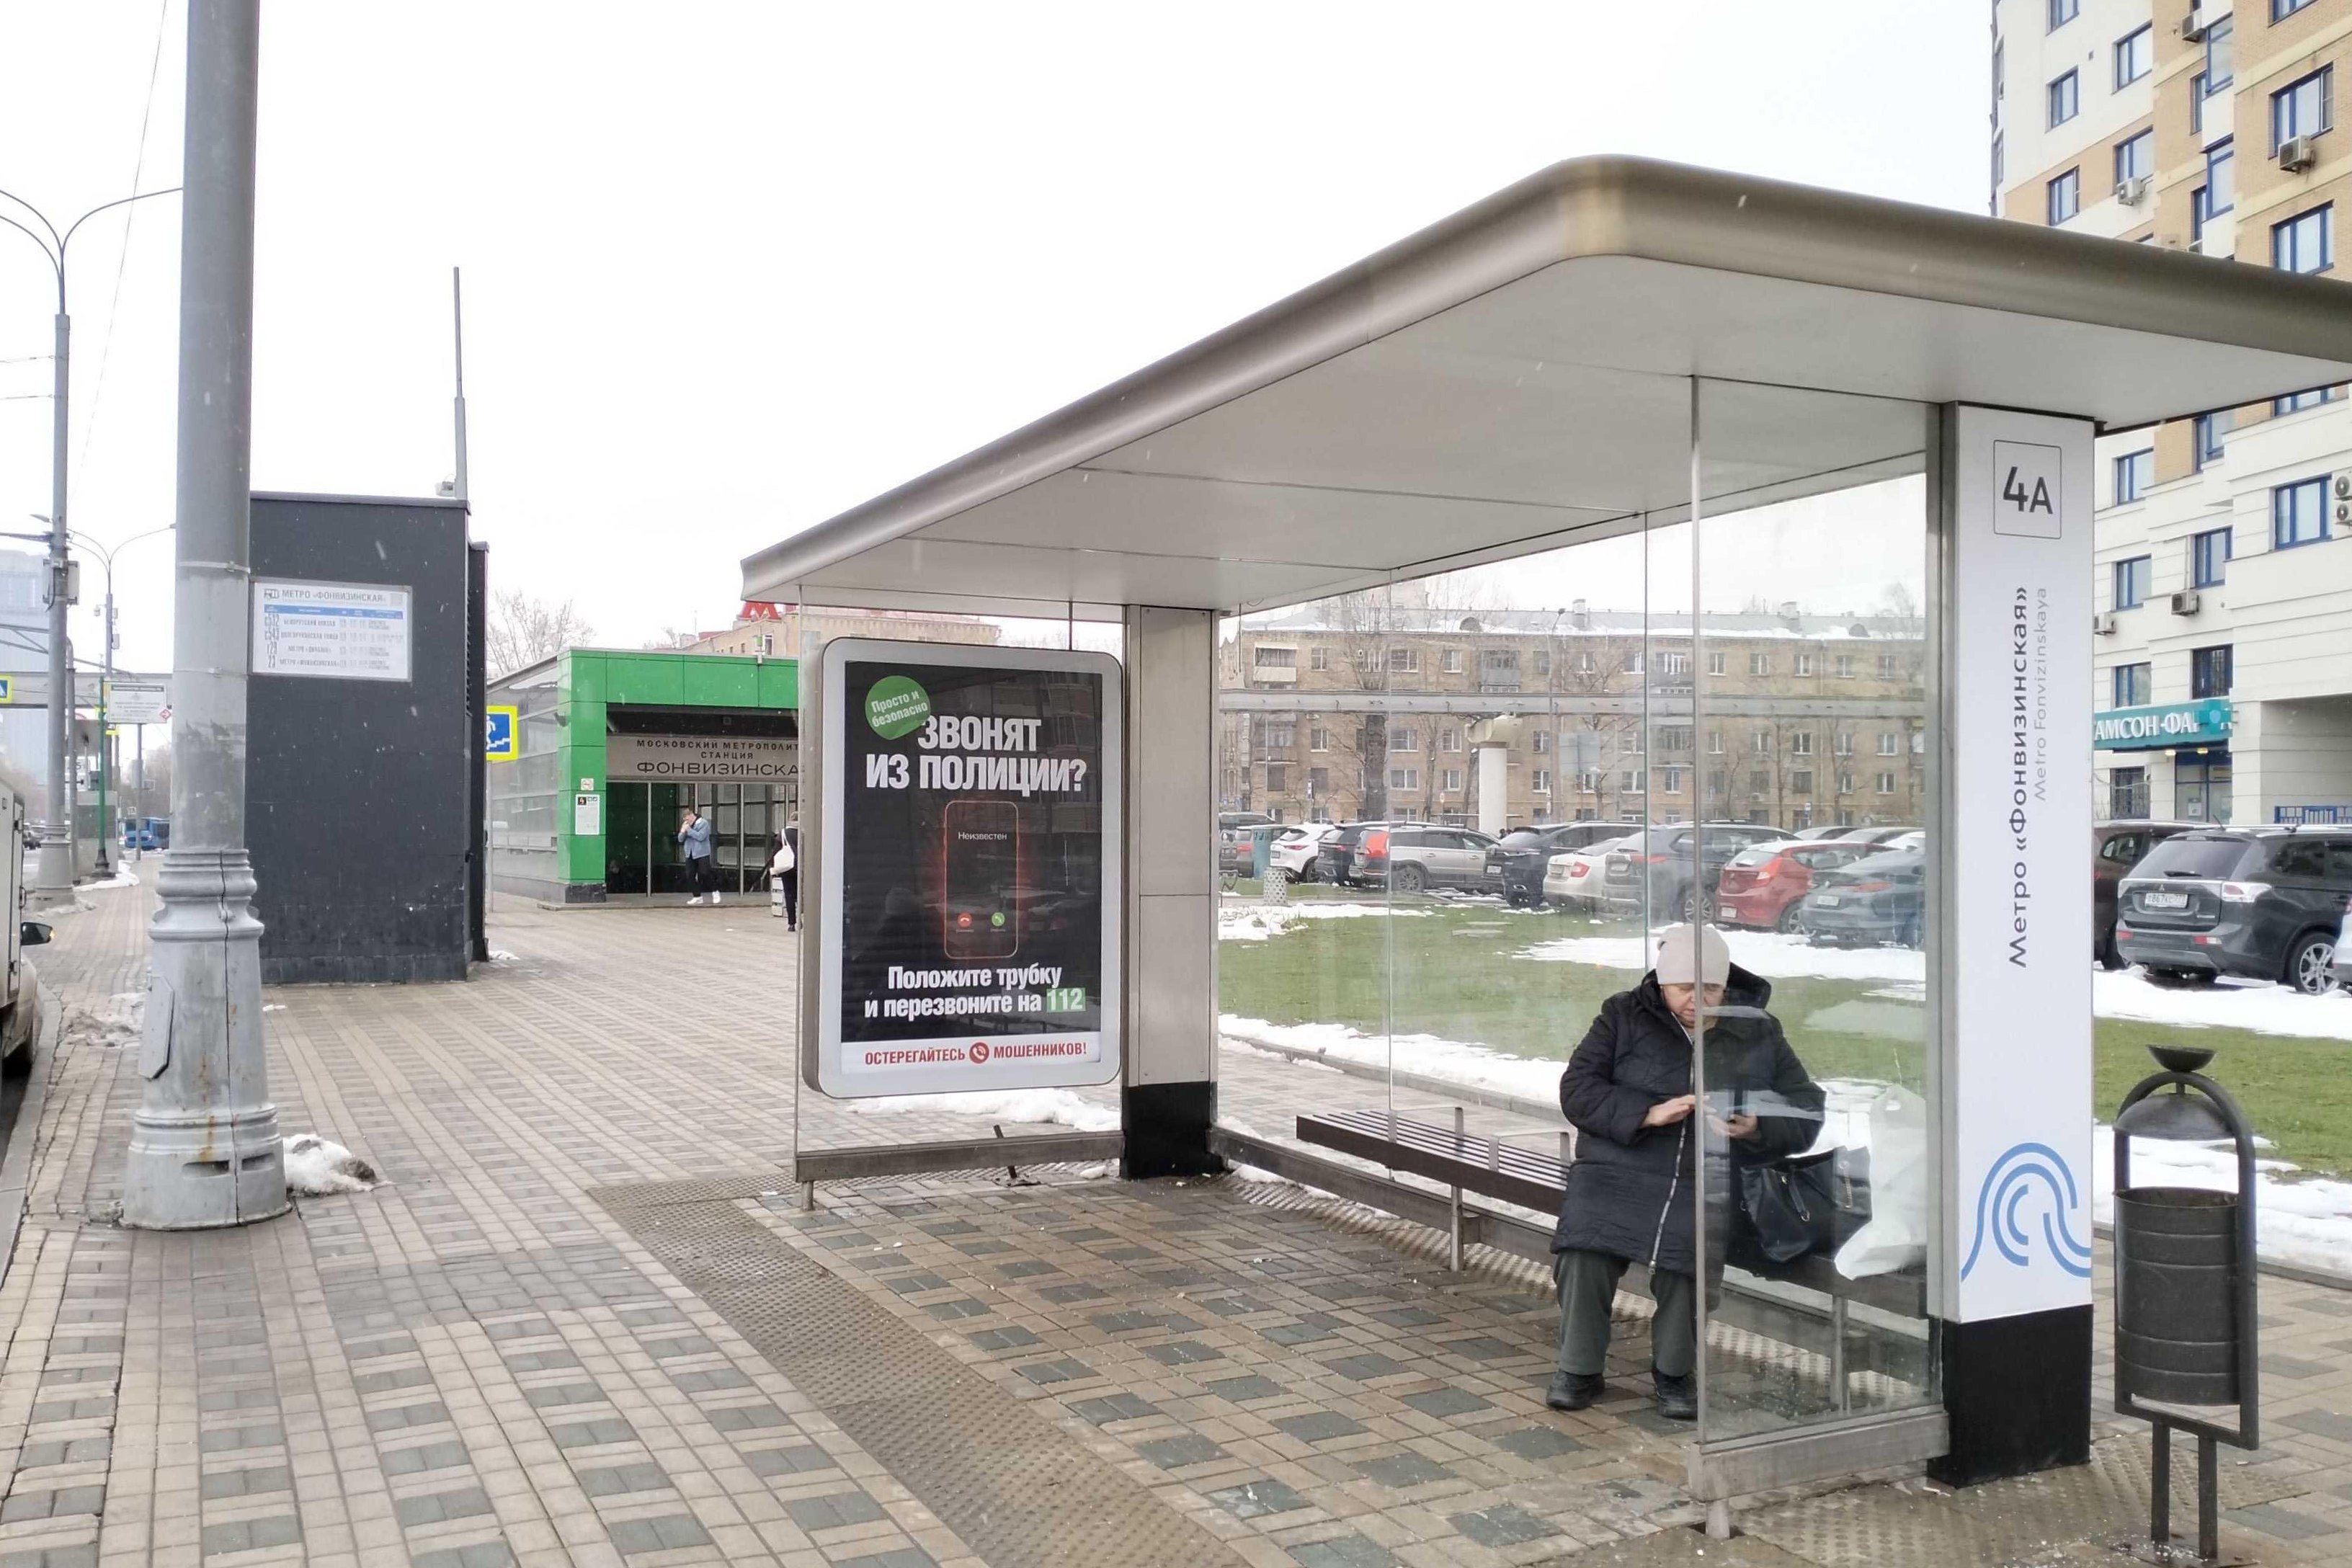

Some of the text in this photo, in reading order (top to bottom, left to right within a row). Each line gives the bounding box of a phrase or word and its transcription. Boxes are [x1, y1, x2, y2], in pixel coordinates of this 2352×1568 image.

[282, 589, 311, 599] МЕТРО
[871, 690, 919, 713] Просто и
[2034, 587, 2049, 801] Metro Fonvizinskaya
[872, 703, 928, 727] безопасно
[917, 715, 1041, 752] ЗВОНЯТ
[701, 751, 754, 760] СТАНЦИЯ
[866, 754, 1087, 798] ИЗ ПОЛИЦИИ?
[2009, 587, 2031, 968] Метро «Фонвизинская»
[958, 832, 1007, 841] Неизвестен
[888, 963, 1062, 990] Положите трубку
[865, 988, 1084, 1022] и перезвоните на 112
[865, 1042, 1087, 1065] ОСТЕРЕГАЙТЕСЬ МОШЕННИКОВ!
